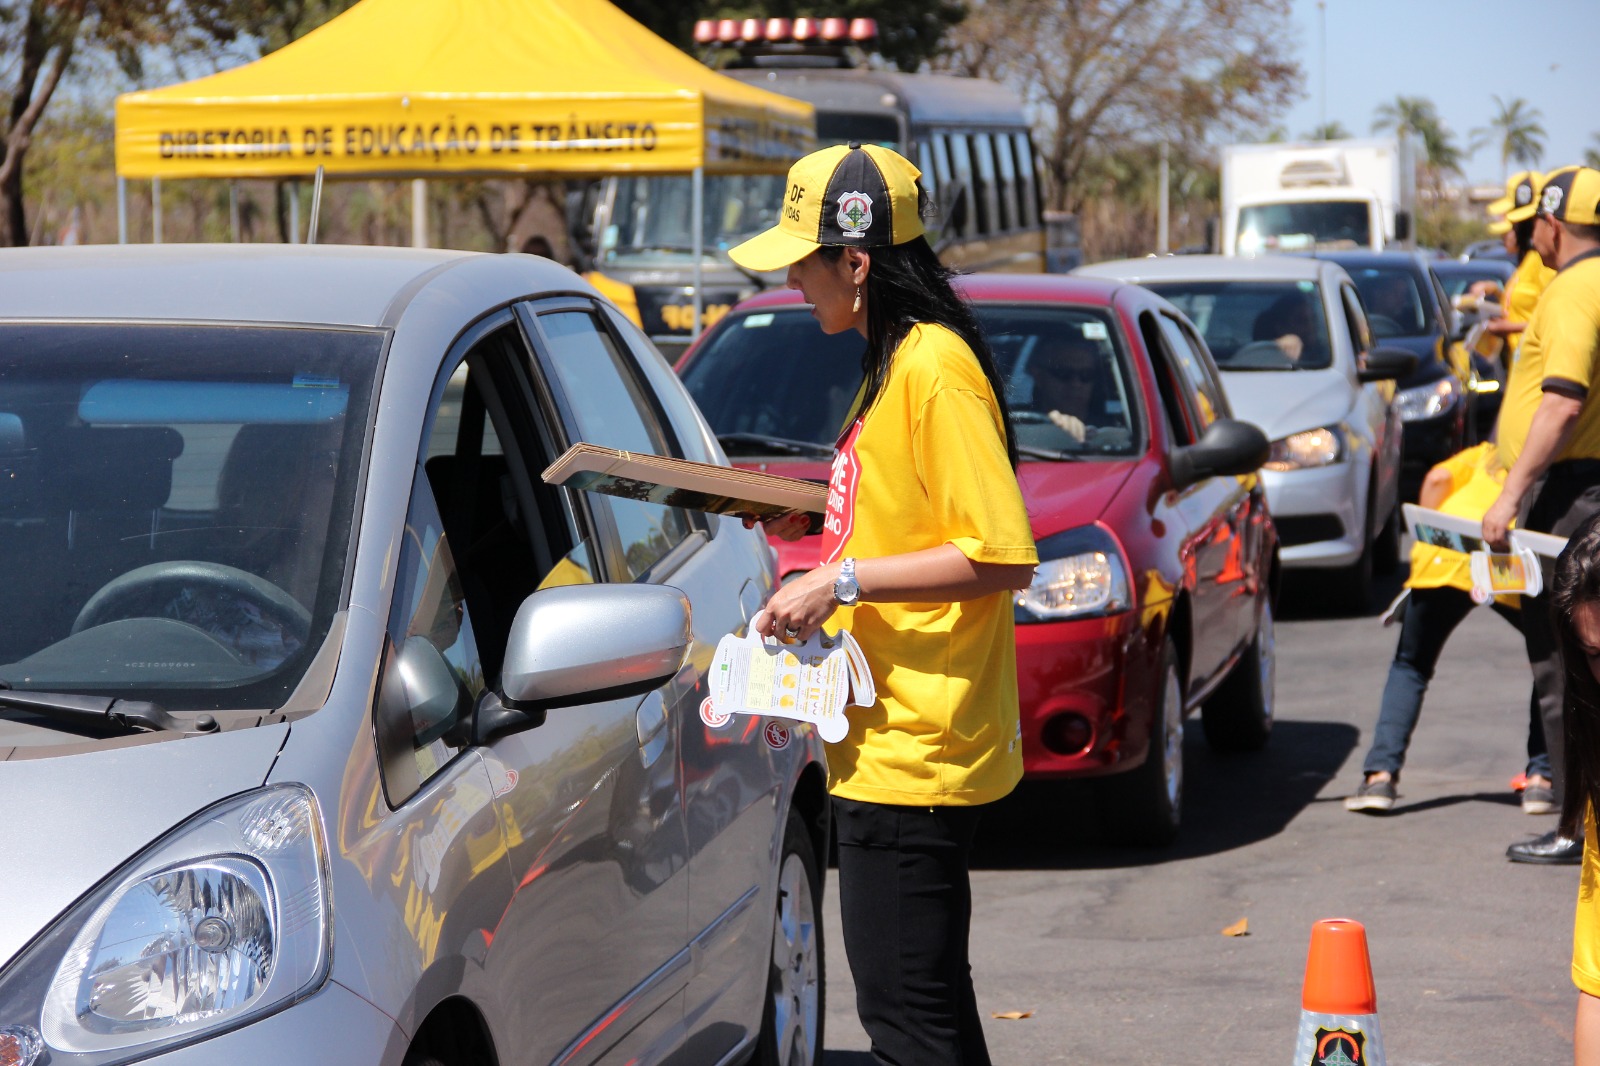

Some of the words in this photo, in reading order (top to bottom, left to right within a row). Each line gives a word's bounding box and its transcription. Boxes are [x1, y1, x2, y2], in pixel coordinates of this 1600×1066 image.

[159, 128, 292, 159] DIRETORIA
[302, 128, 333, 156] DE
[346, 113, 480, 163] EDUCAÇÃO
[490, 125, 520, 153] DE
[533, 112, 657, 152] TRÂNSITO
